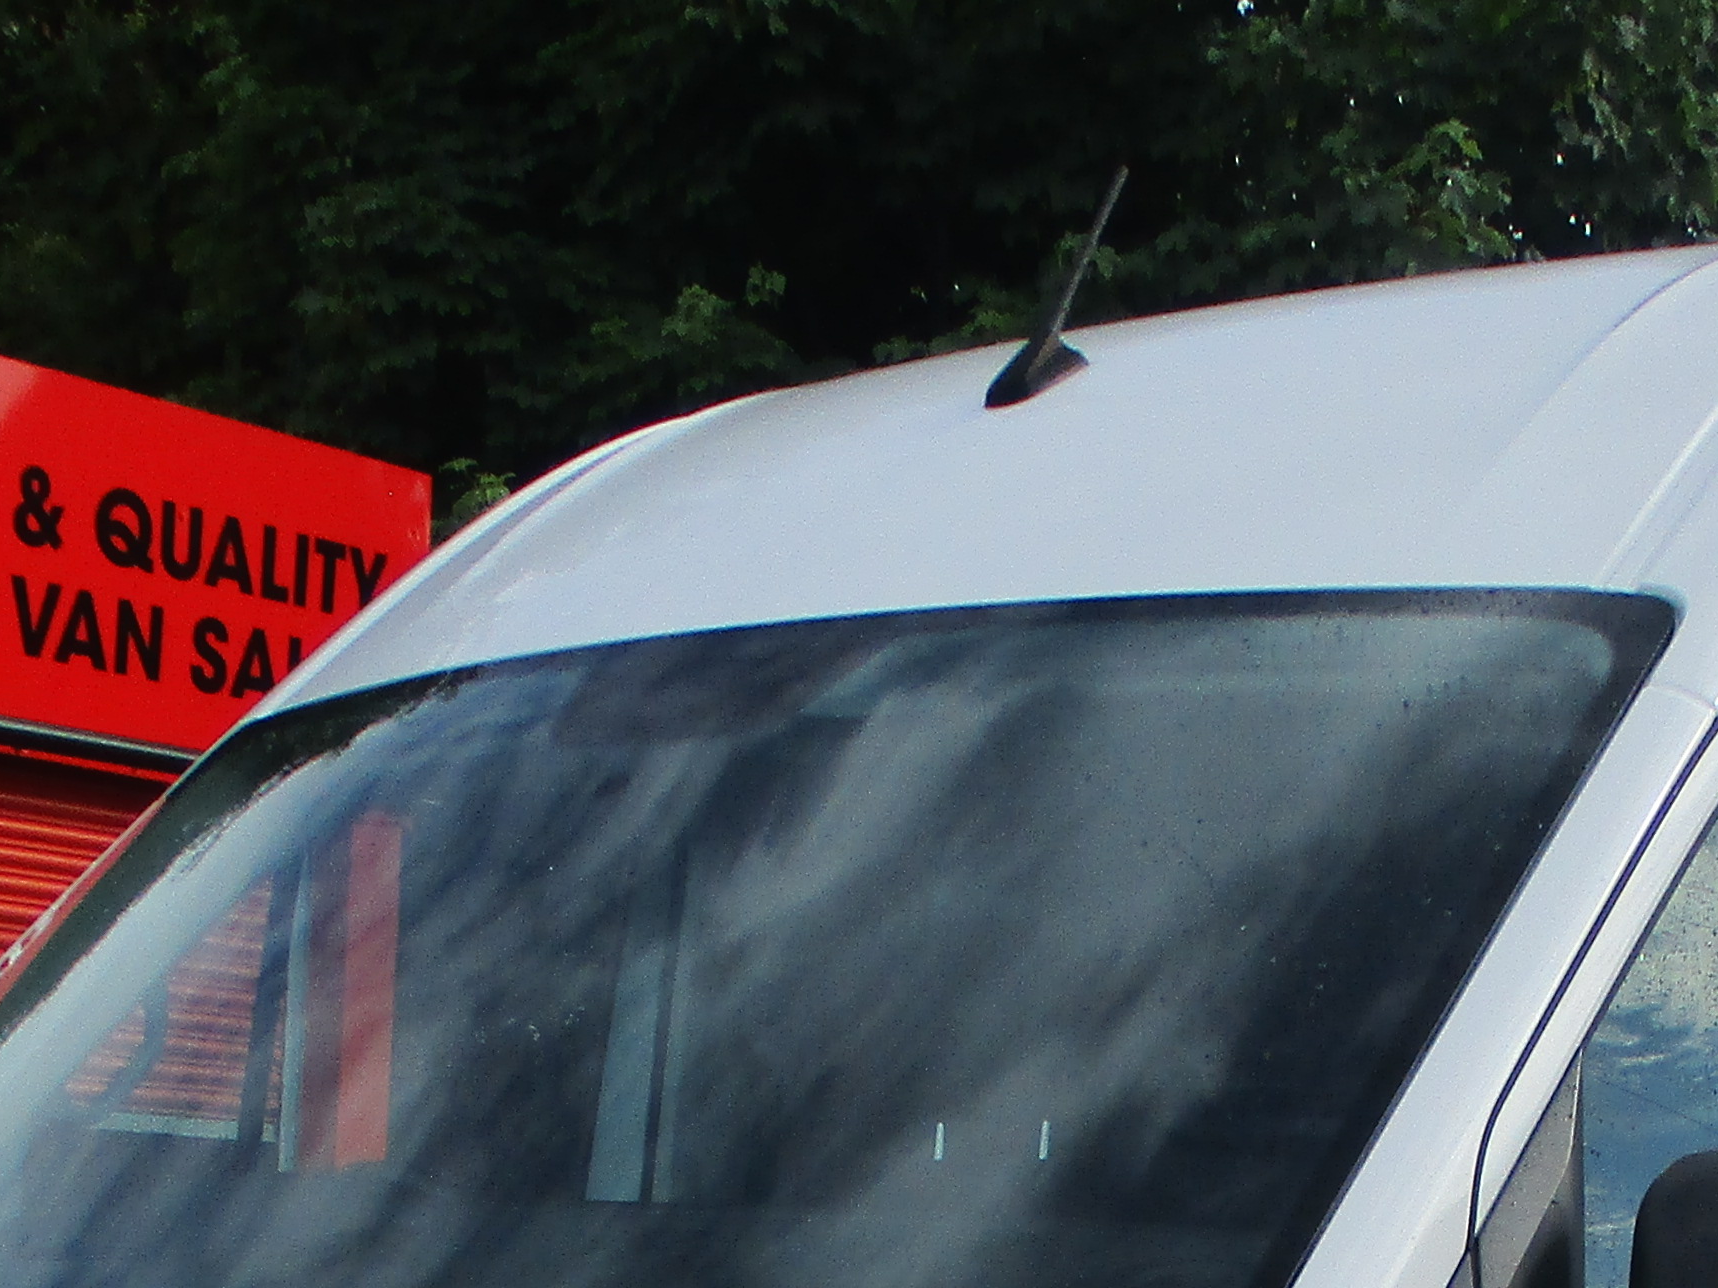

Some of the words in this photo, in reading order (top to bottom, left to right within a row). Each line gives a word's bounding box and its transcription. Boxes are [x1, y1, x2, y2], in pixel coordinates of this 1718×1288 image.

[12, 464, 65, 550] &
[93, 487, 388, 615] QUALITY
[12, 573, 165, 683] VAN
